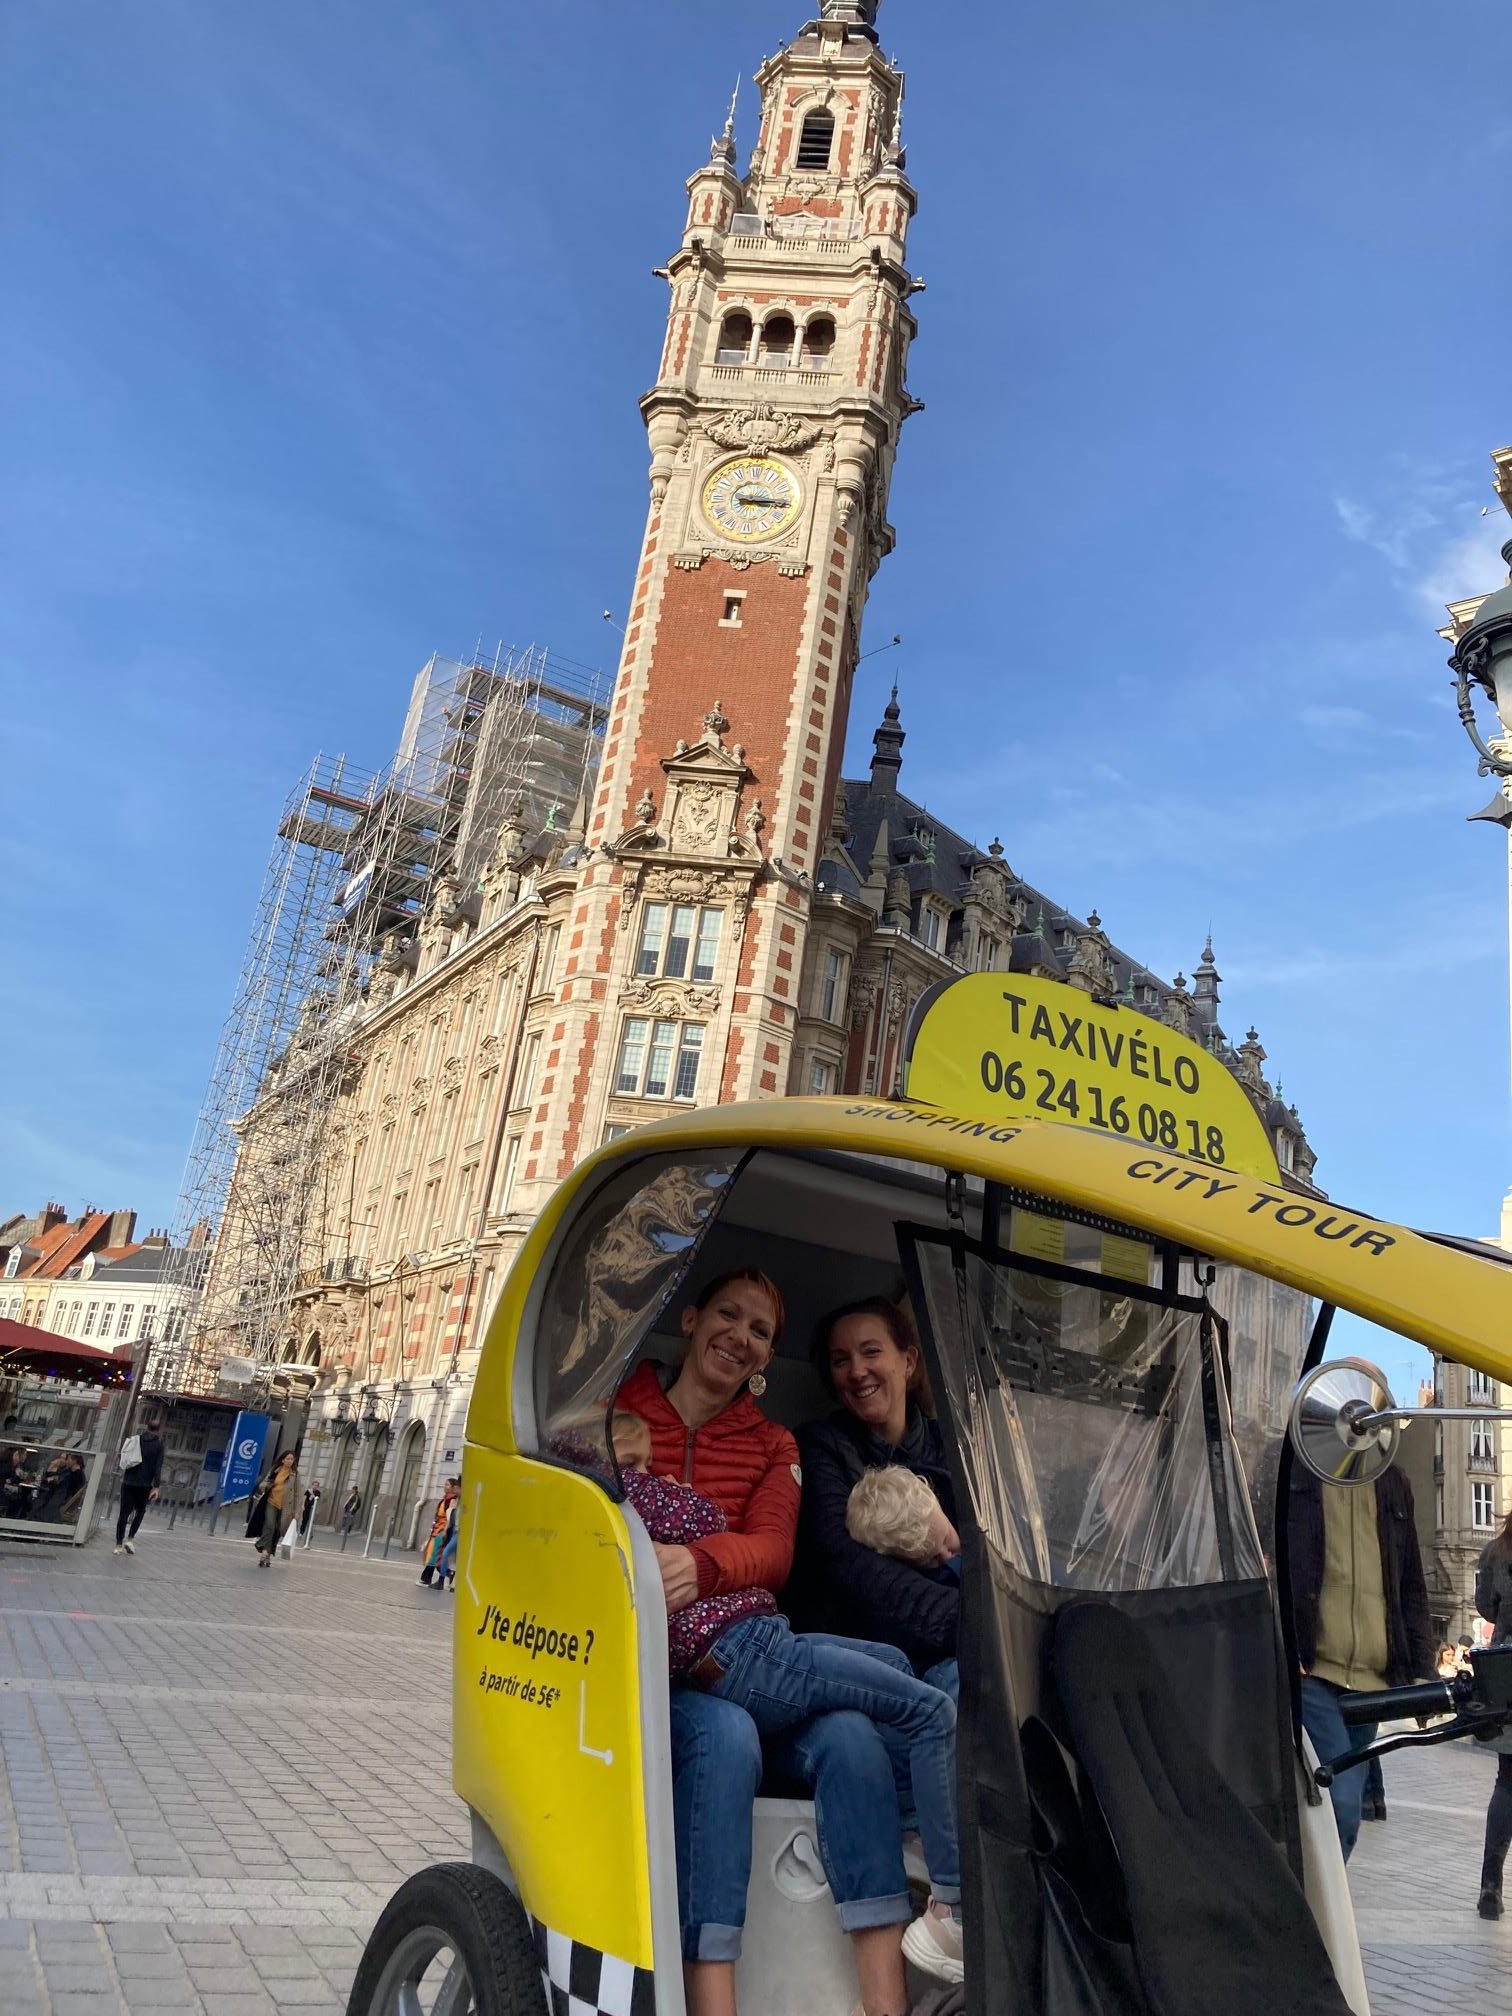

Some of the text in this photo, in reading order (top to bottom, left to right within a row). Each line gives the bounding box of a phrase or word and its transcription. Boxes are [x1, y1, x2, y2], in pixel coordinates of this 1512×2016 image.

[1002, 990, 1200, 1095] TAXIVÉLO
[845, 1104, 1023, 1144] SHOPPING
[980, 1050, 1225, 1165] 06 24 16 08 18
[1126, 1160, 1396, 1257] CITY TOUR
[511, 1612, 579, 1662] dépose
[583, 1629, 595, 1665] ?
[479, 1665, 487, 1687] à
[486, 1672, 520, 1697] partir
[520, 1679, 537, 1703] de
